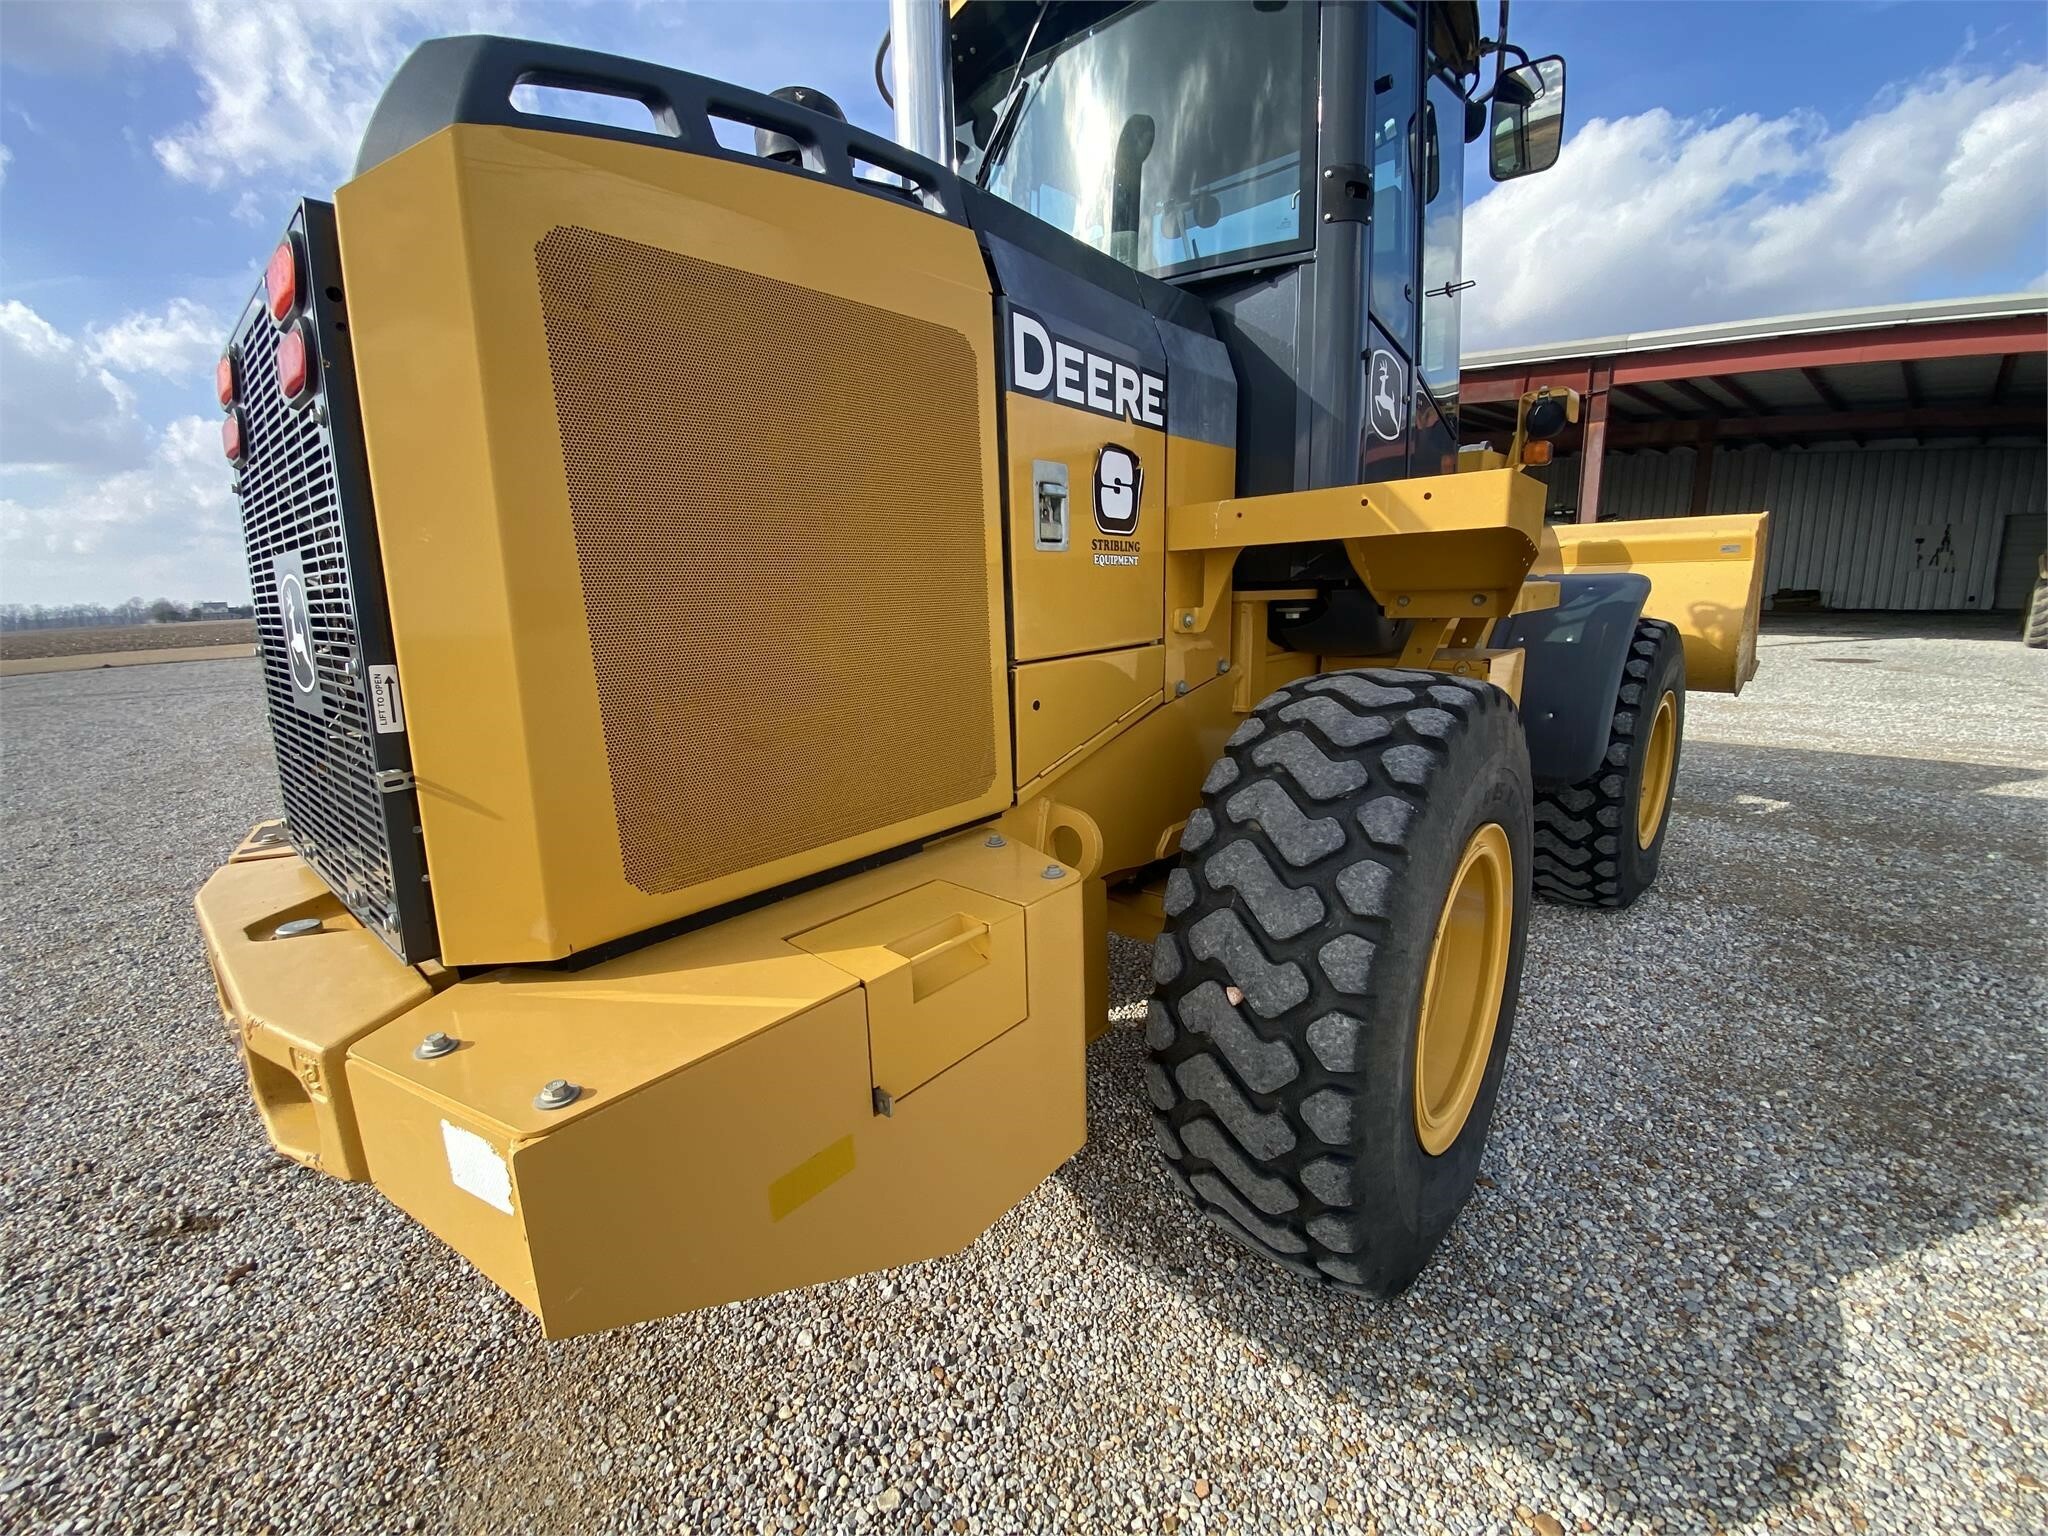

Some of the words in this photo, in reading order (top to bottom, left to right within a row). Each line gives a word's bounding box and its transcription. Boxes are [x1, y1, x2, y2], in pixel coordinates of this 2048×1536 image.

[1013, 312, 1164, 426] DEERE
[1091, 538, 1141, 553] STRIBLING
[1094, 554, 1139, 566] EQUIPMENT
[374, 673, 383, 696] OPEN
[377, 697, 385, 708] TO
[379, 709, 388, 726] LIFT
